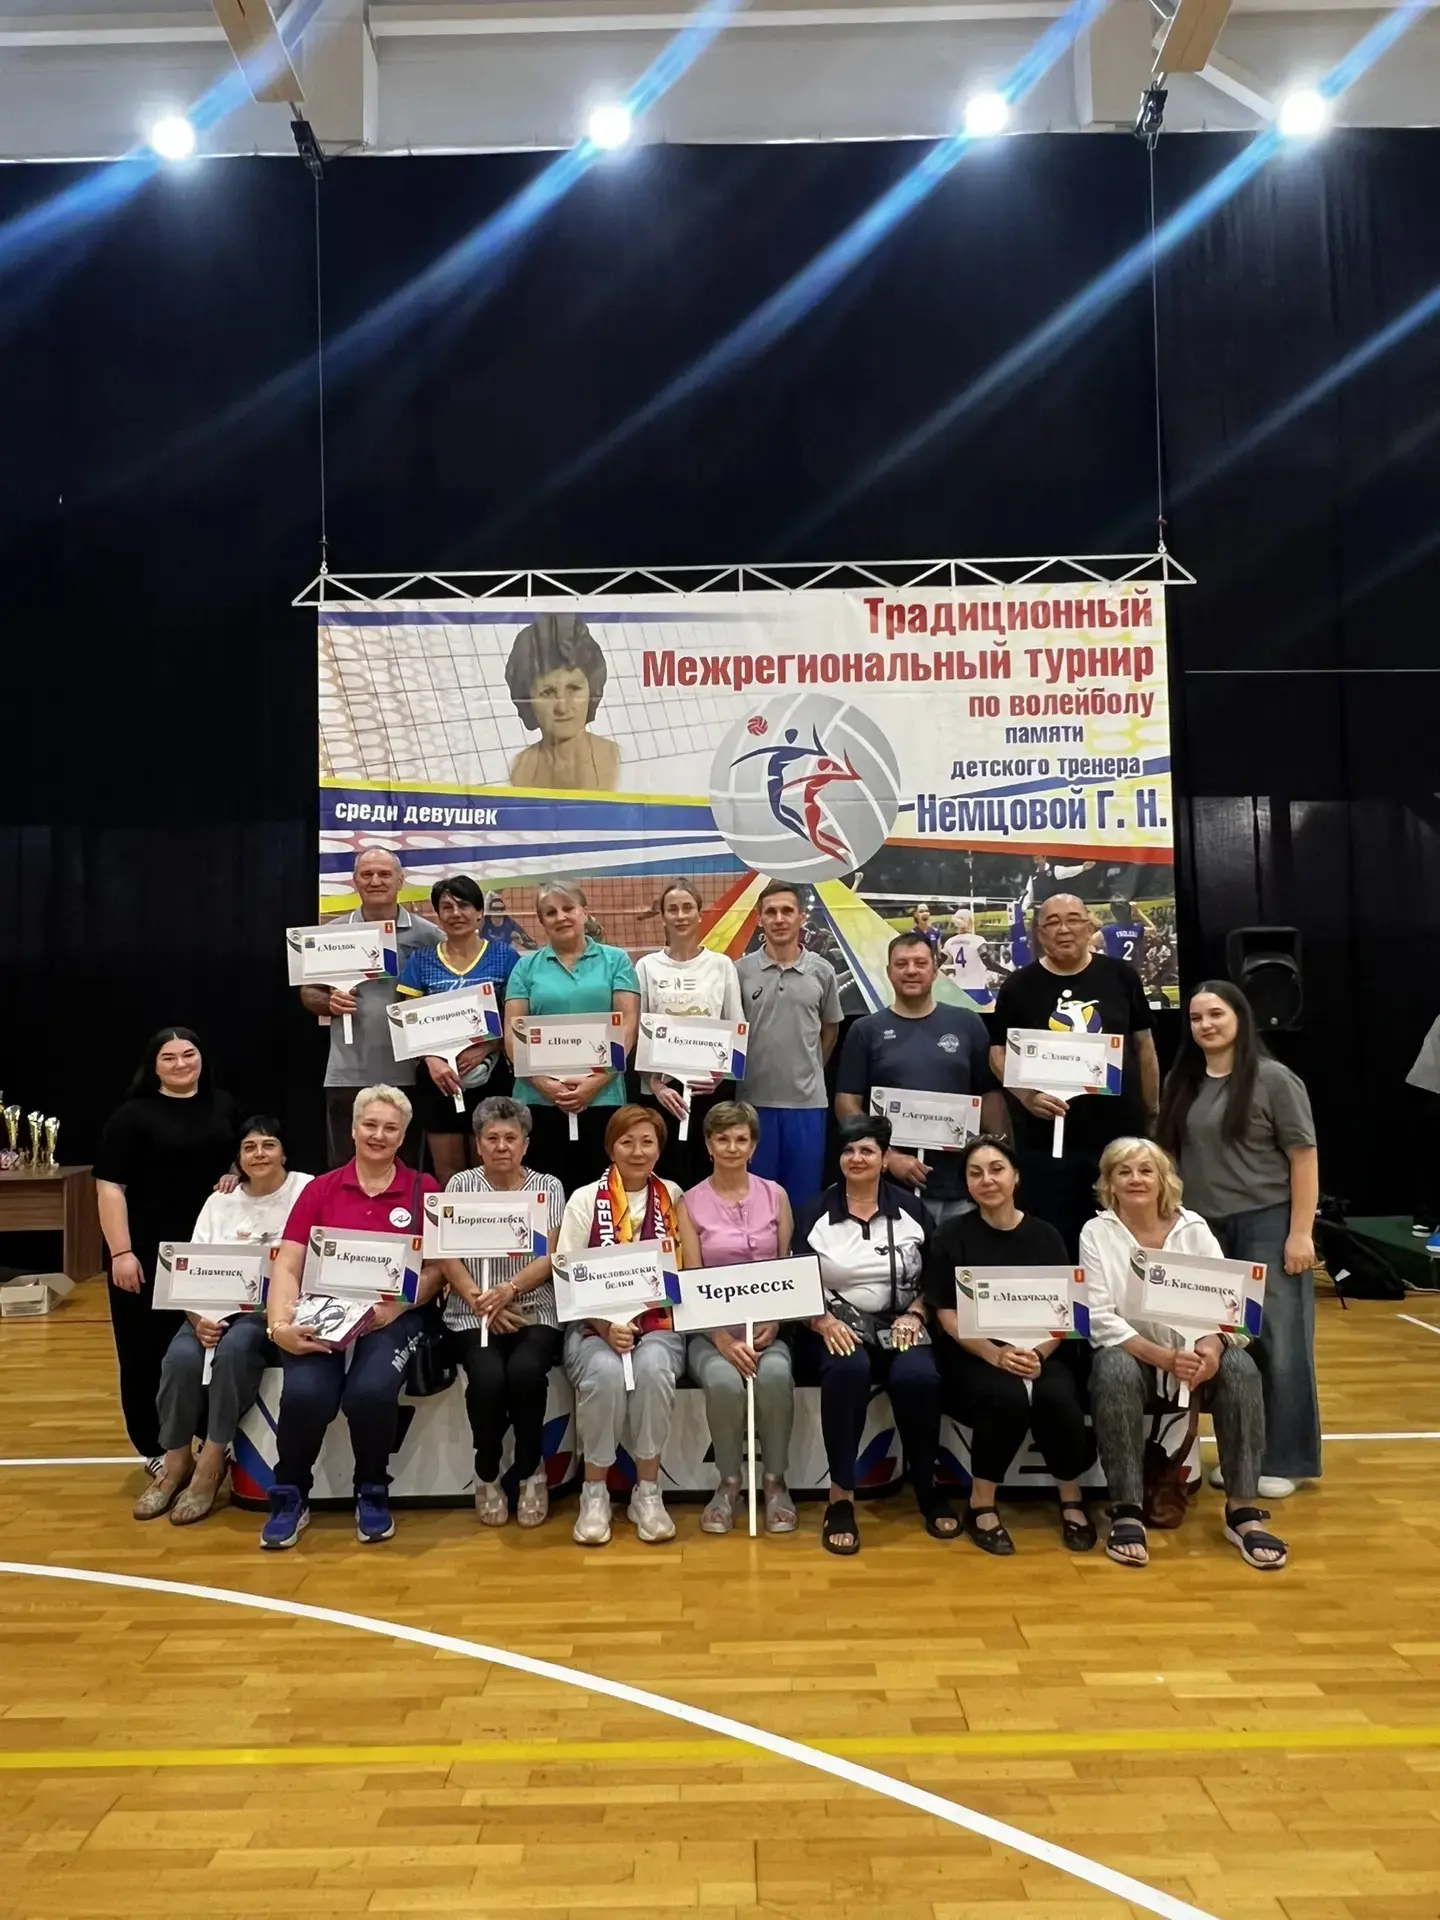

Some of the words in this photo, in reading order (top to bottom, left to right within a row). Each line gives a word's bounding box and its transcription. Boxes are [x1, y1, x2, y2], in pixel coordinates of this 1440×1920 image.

[863, 587, 1153, 640] Традиционный
[642, 639, 1012, 692] Межрегиональный
[1023, 645, 1155, 684] турнир
[968, 695, 1001, 718] по
[1009, 687, 1155, 718] волейболу
[1005, 725, 1084, 744] памяти
[950, 758, 1050, 780] детского
[1057, 756, 1141, 778] тренера
[335, 802, 399, 823] среди
[403, 806, 498, 827] девушек
[916, 787, 1087, 836] Немцовой
[1096, 790, 1126, 829] Г.
[1136, 788, 1168, 828] Н.
[955, 946, 967, 968] 4
[1122, 940, 1134, 961] 2
[451, 1213, 525, 1226] г.Борисоглебск
[596, 1199, 616, 1248] БЕЛК
[336, 1252, 392, 1266] г.Краснодар
[189, 1267, 243, 1277] г.Знаменск
[605, 1280, 634, 1290] белки
[696, 1279, 795, 1303] Черкесск
[1164, 1278, 1236, 1296] г.Кисловодск
[993, 1292, 1060, 1302] г.Махачкала
